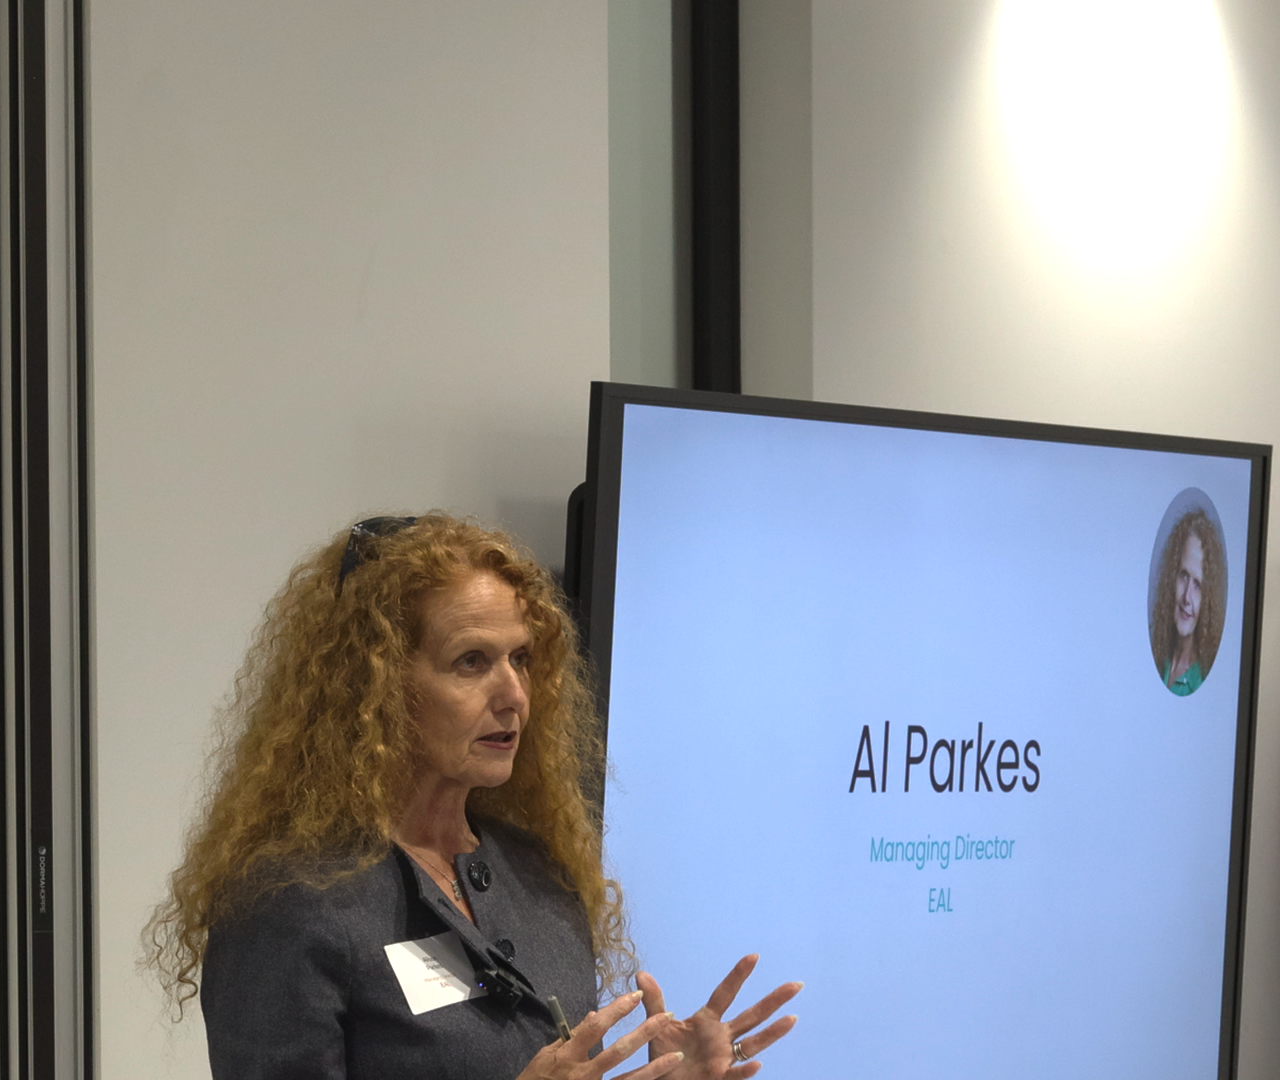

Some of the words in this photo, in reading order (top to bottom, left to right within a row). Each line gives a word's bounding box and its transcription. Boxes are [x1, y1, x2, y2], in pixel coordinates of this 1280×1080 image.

[849, 720, 890, 793] Al
[904, 721, 1041, 793] Parkes
[870, 834, 951, 870] Managing
[955, 833, 1016, 860] Director
[928, 887, 954, 913] EAL
